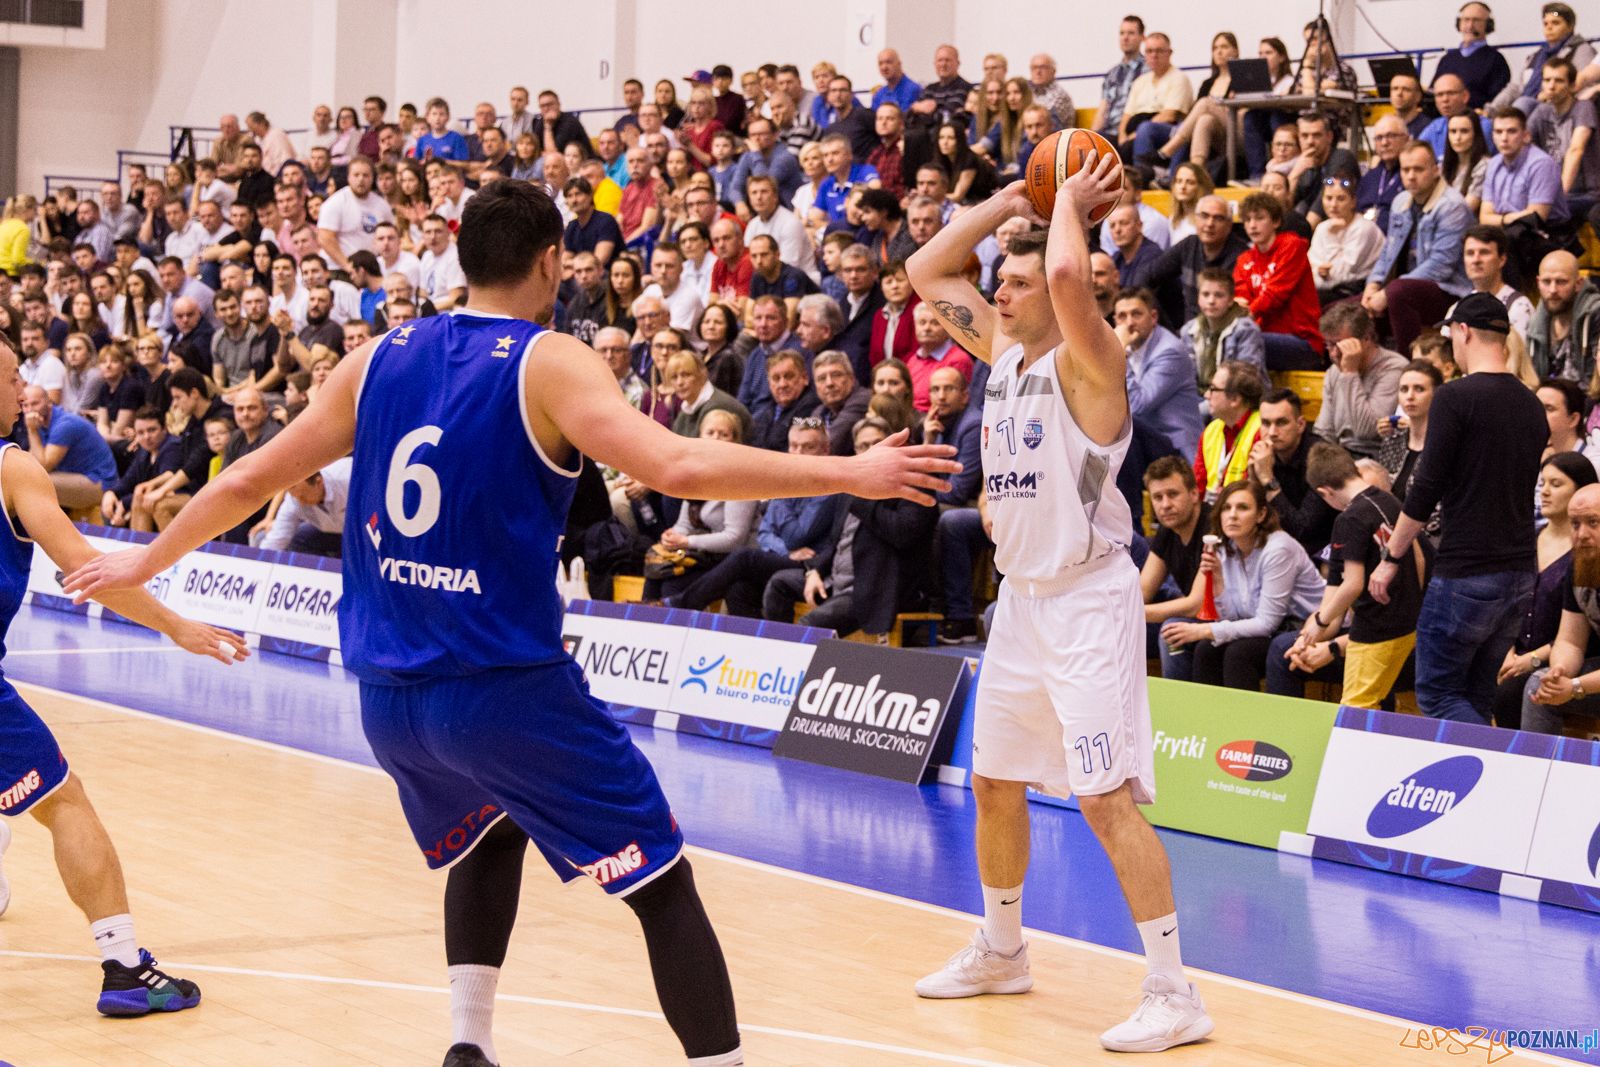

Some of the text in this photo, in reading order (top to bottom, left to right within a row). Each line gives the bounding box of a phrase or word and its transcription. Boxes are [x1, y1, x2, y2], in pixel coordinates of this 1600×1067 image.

[859, 24, 872, 46] C
[600, 60, 609, 80] D
[1034, 164, 1042, 187] FIBA
[385, 425, 444, 538] 6
[184, 568, 257, 605] BIOFARM
[379, 556, 482, 594] VICTORIA
[583, 641, 671, 685] NICKEL
[715, 685, 793, 708] biuro podró
[798, 666, 941, 737] drukma
[789, 716, 927, 756] DRUKARNIA SKOCZYŃSKI
[1074, 732, 1112, 774] 11
[1153, 730, 1207, 760] Frytki
[1220, 749, 1289, 771] FARM FRITES
[1207, 780, 1287, 803] the fresh taste of the land
[1387, 778, 1456, 814] atrem
